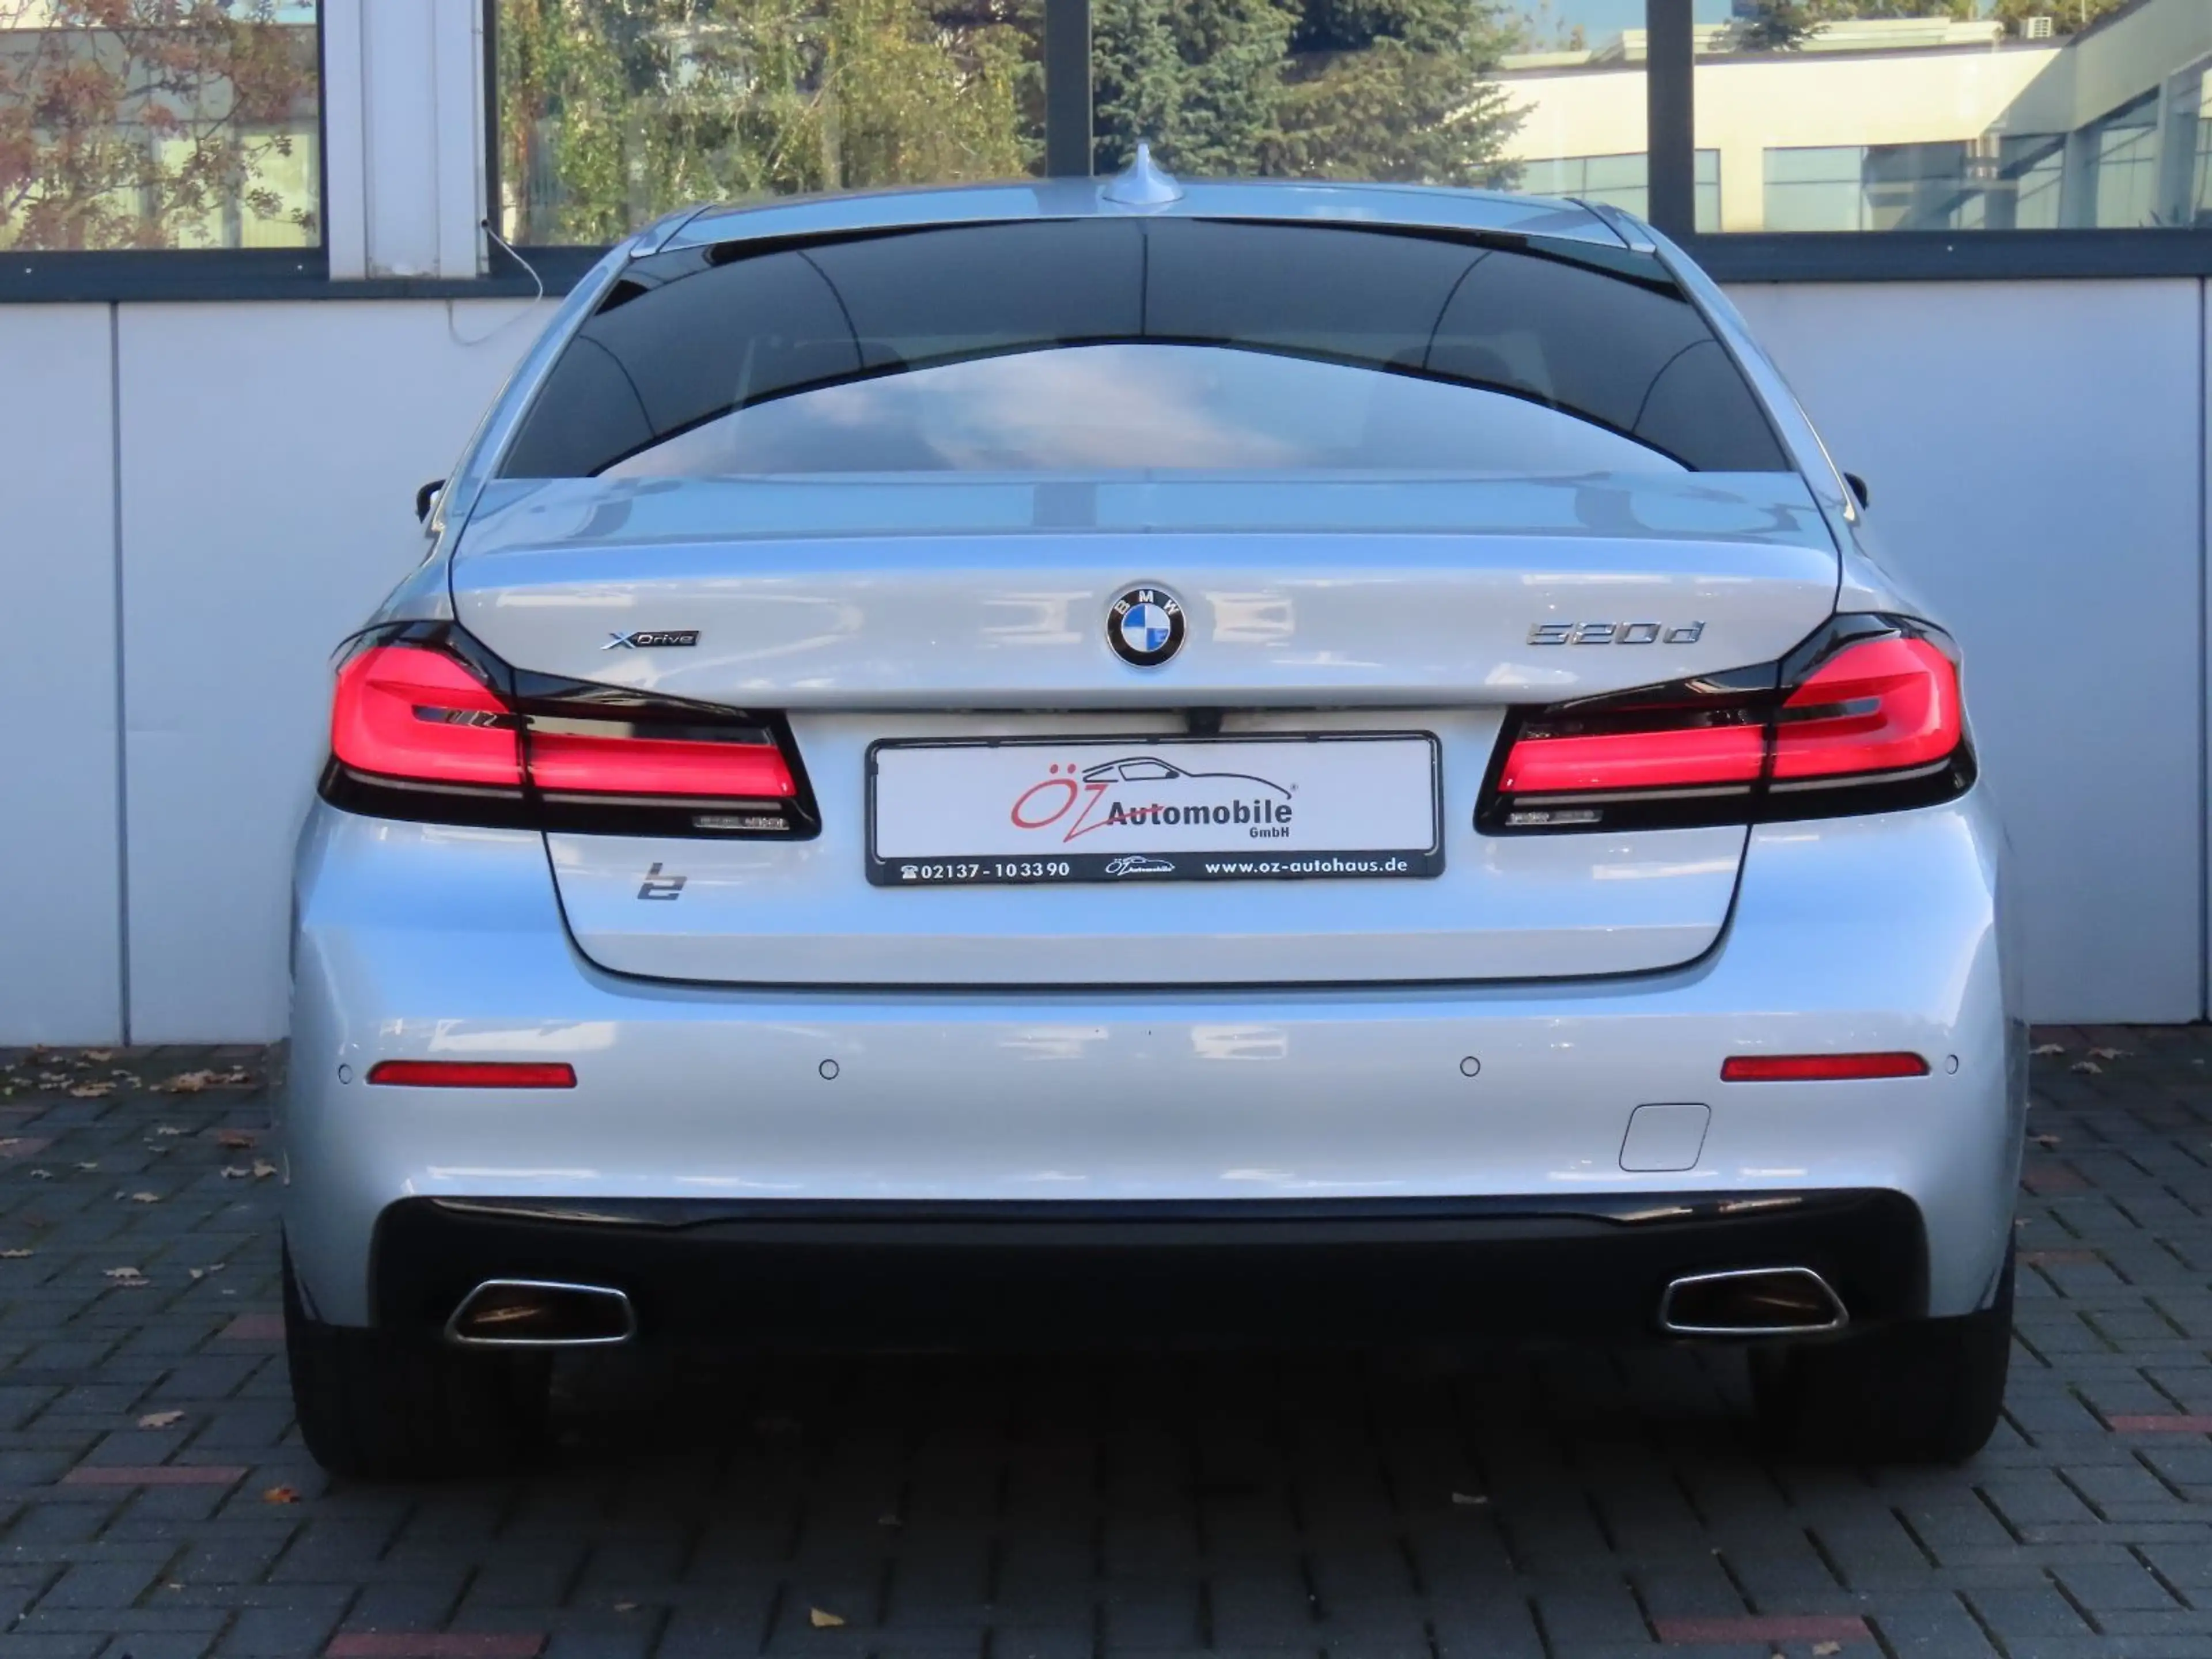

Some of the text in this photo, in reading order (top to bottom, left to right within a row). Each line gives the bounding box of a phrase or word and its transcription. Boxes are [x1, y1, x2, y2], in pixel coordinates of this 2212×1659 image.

[1114, 590, 1181, 616] BMW
[1527, 620, 1707, 645] 520d
[1107, 800, 1293, 825] Automobile
[1249, 827, 1289, 838] GmbH
[1205, 857, 1408, 873] www.oz-autohaus.de
